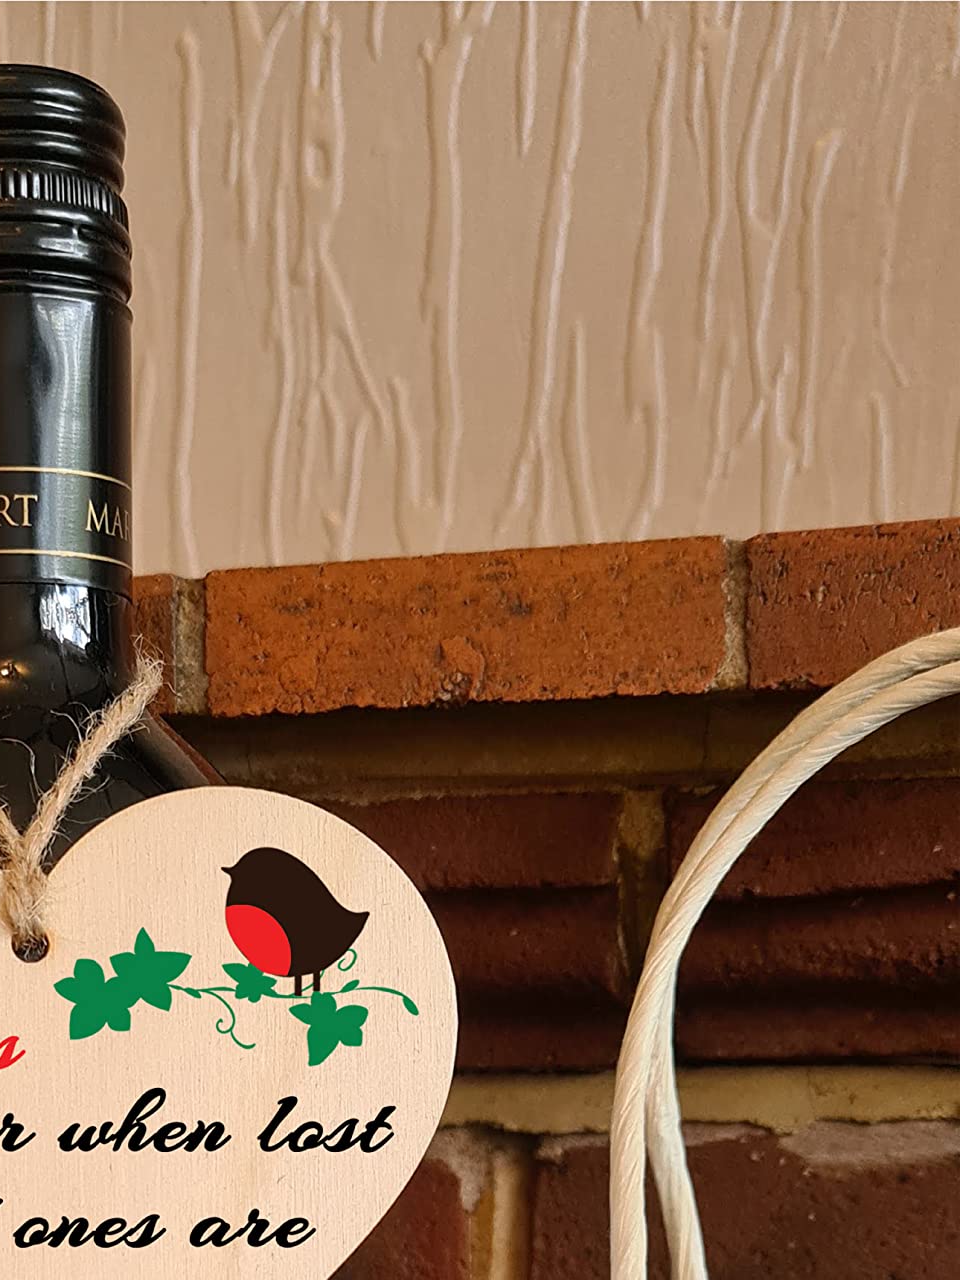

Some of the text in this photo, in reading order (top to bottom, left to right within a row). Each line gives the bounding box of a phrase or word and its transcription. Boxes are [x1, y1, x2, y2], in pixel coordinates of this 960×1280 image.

[58, 1088, 233, 1153] when
[258, 1096, 397, 1153] lost
[13, 1214, 167, 1249] ones
[190, 1208, 317, 1249] are
